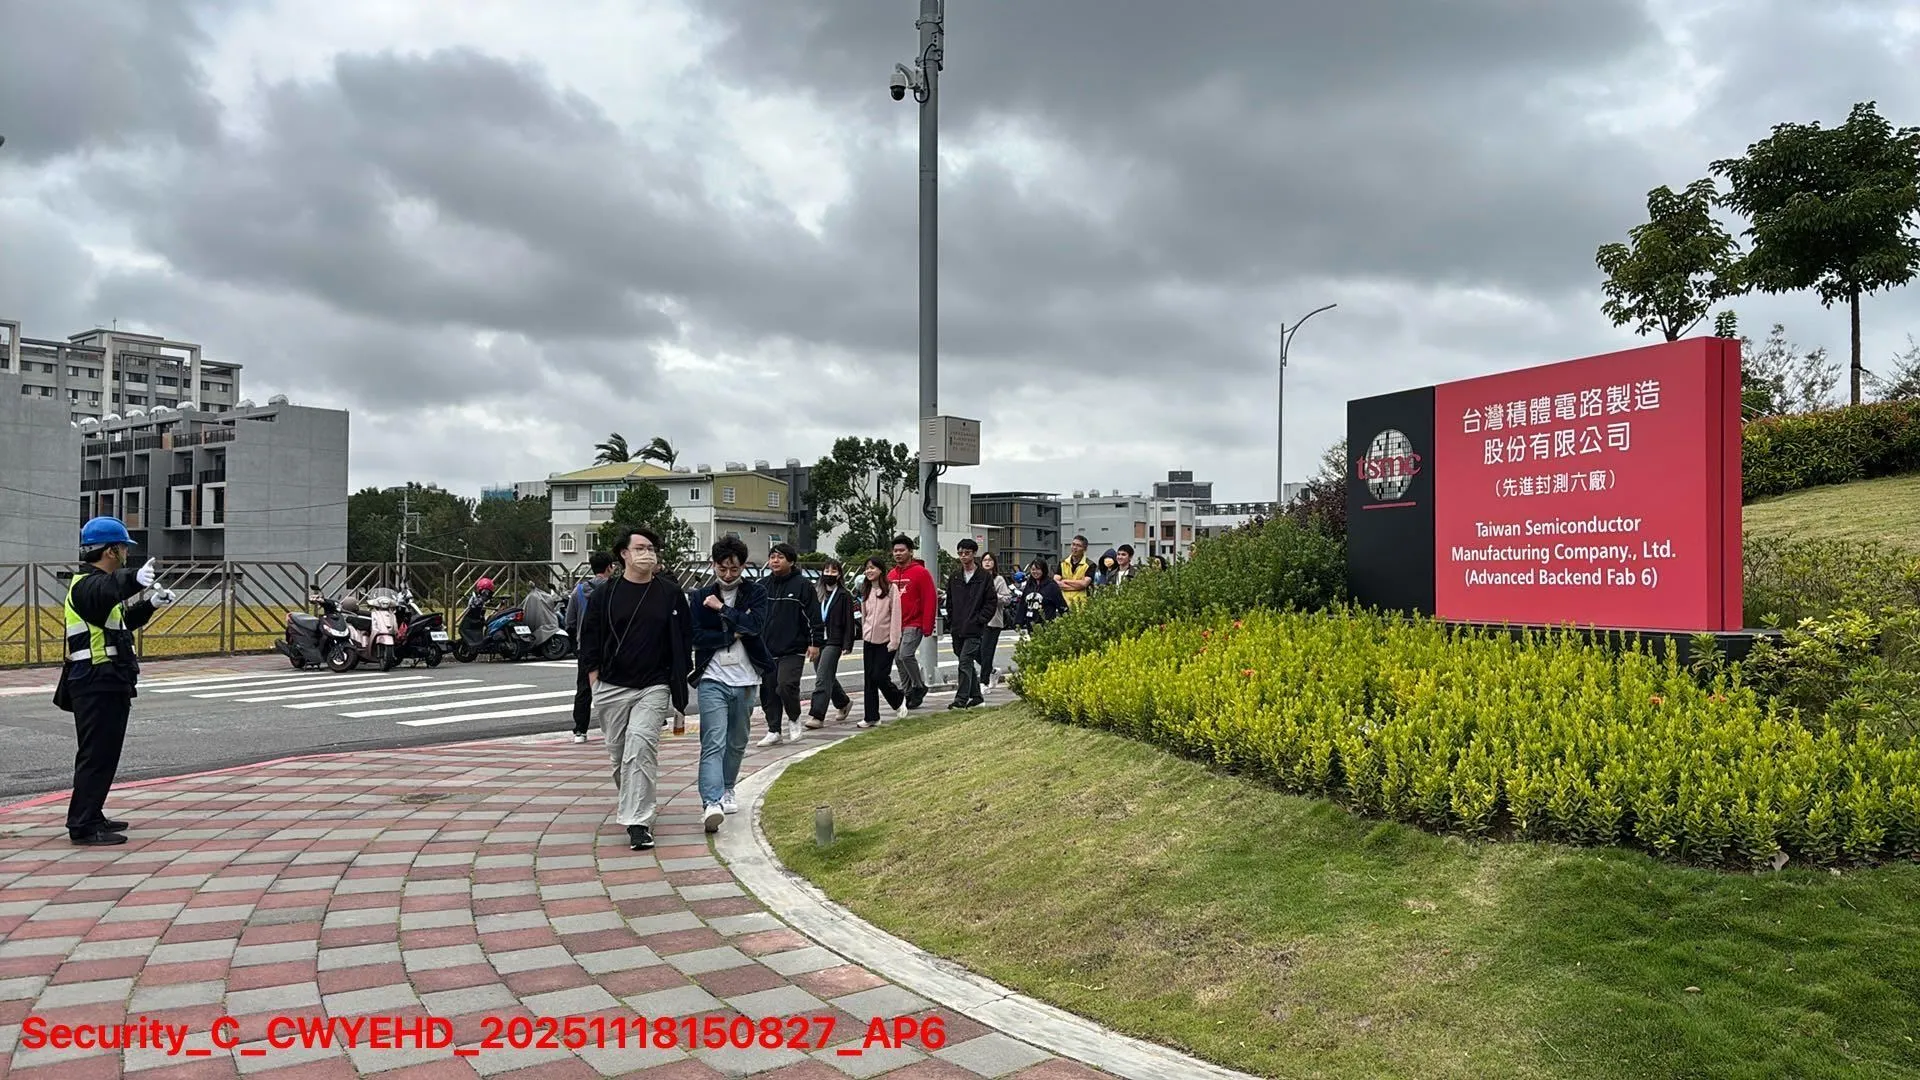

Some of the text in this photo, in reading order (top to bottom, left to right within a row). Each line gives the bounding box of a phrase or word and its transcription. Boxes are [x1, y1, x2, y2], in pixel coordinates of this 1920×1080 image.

[1462, 379, 1661, 434] 台灣積體電路製造
[1483, 421, 1631, 465] 股份有限公司
[1356, 452, 1422, 480] tsmc
[1475, 515, 1642, 538] Taiwan Semiconductor
[1451, 539, 1676, 565] Manufacturing Company., Ltd.
[1465, 566, 1658, 589] (Advanced Backend Fab 6)
